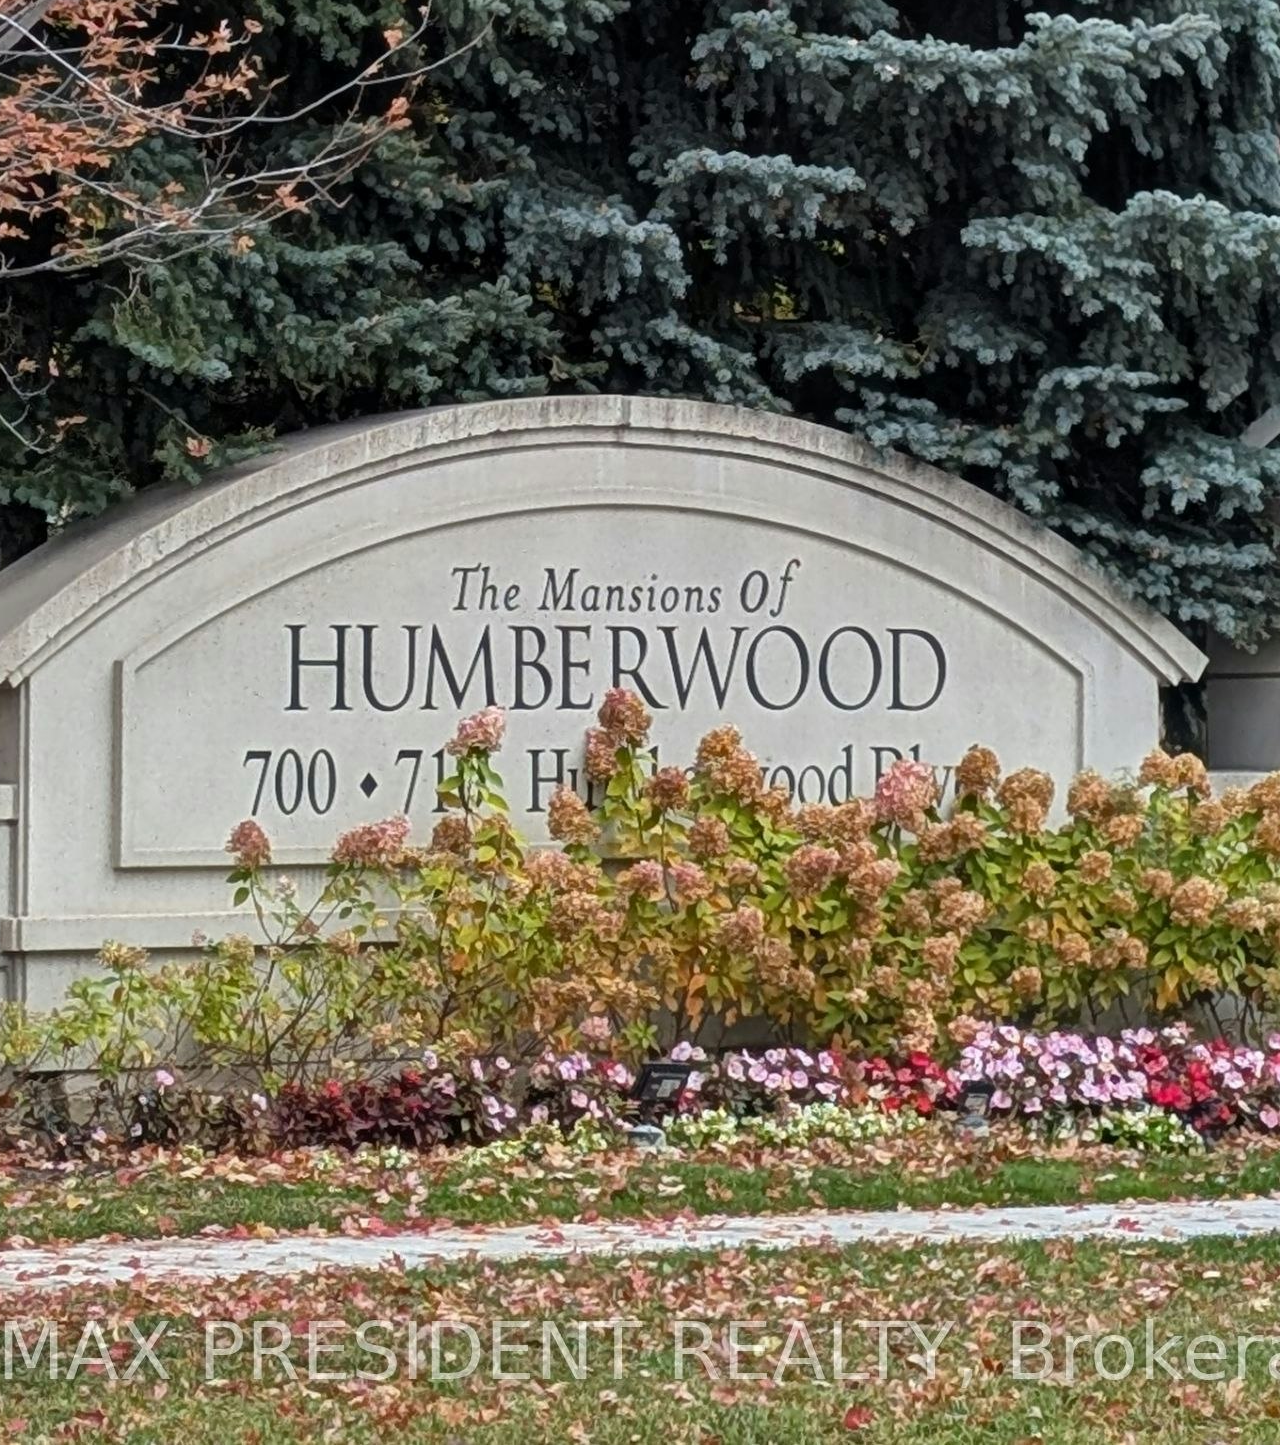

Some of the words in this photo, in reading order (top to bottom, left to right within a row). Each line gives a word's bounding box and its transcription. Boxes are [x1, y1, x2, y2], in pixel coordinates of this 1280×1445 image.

[451, 562, 520, 611] The
[538, 567, 722, 612] Mansions
[740, 558, 801, 617] Of
[284, 624, 947, 711] HUMBERWOOD
[243, 748, 337, 816] 700
